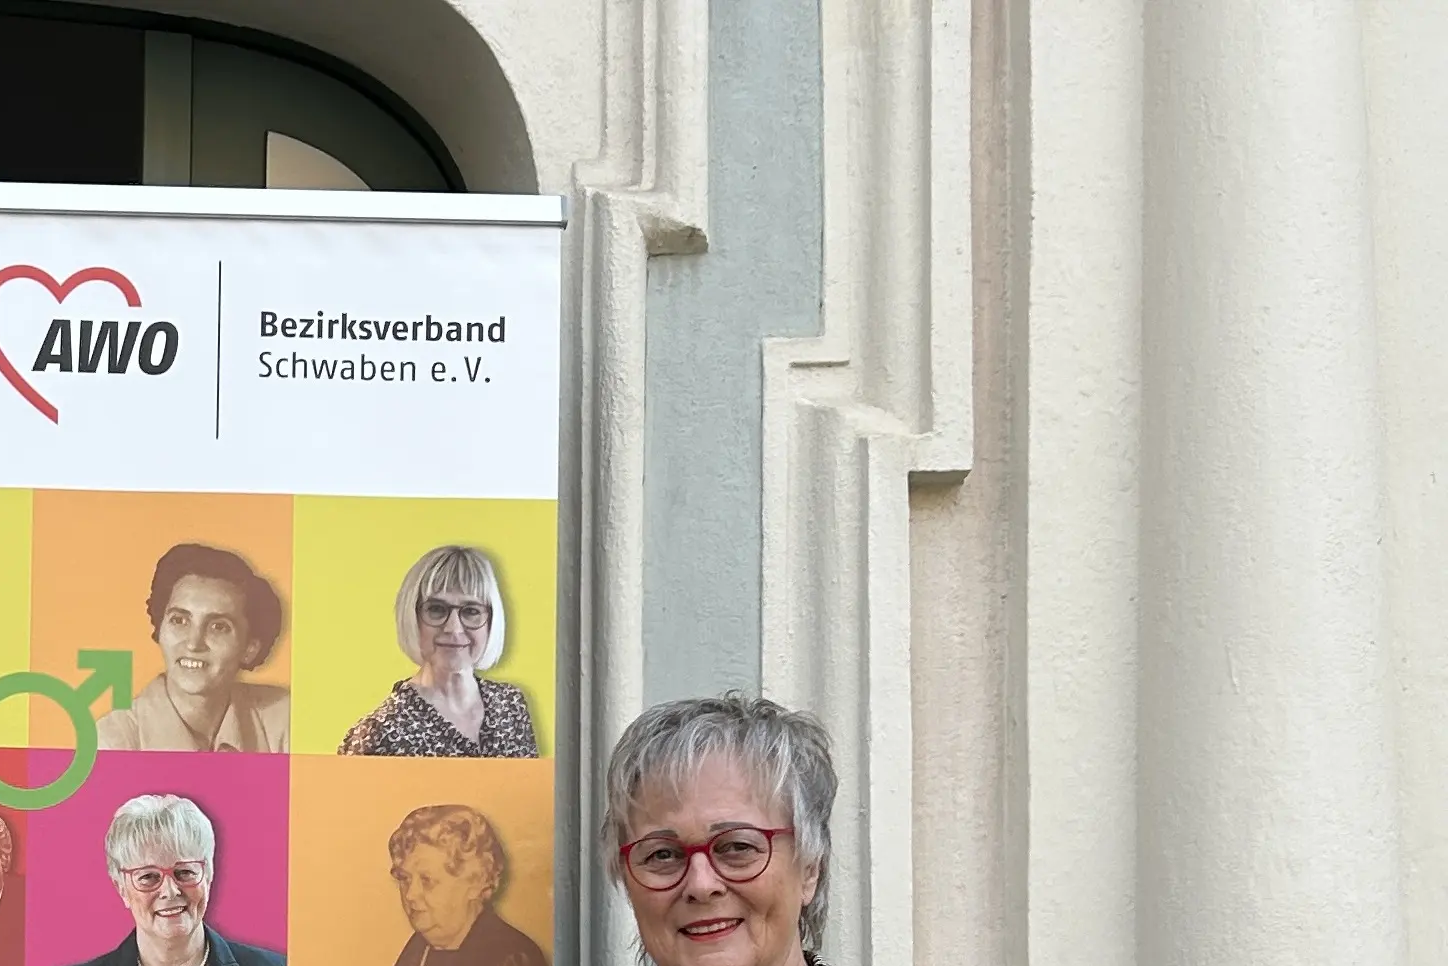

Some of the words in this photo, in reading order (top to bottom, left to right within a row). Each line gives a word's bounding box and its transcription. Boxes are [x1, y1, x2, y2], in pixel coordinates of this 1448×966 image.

[259, 310, 506, 343] Bezirksverband
[31, 318, 179, 376] AWO
[258, 351, 417, 382] Schwaben
